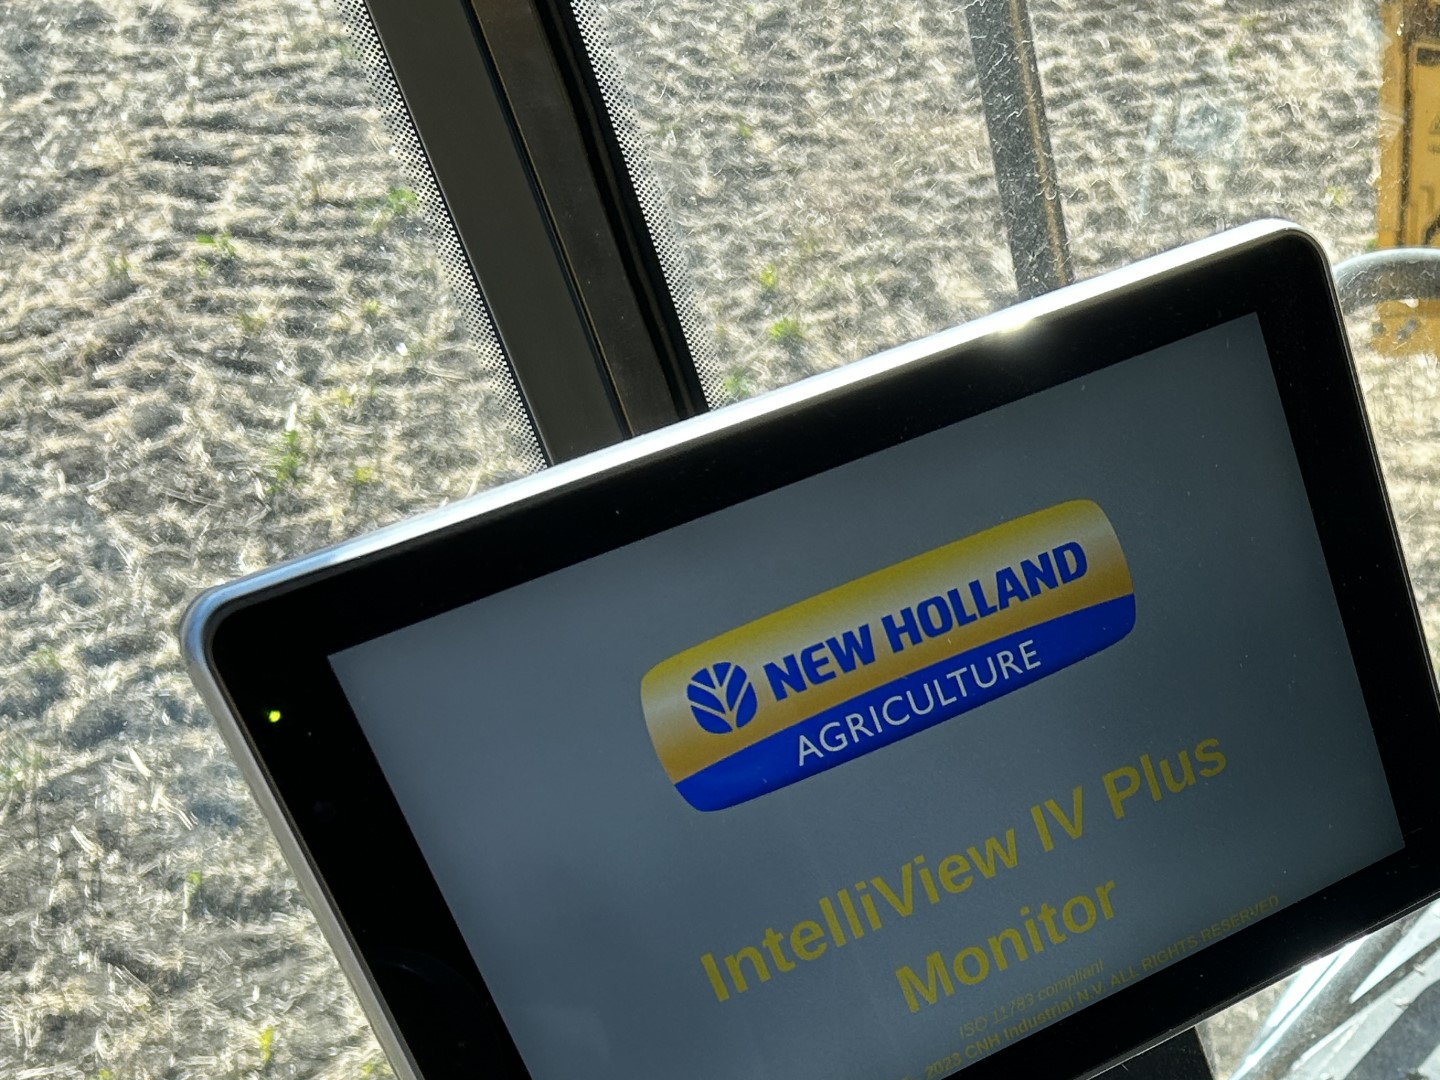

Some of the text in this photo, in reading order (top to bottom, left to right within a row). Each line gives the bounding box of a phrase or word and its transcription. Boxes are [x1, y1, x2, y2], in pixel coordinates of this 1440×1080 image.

[763, 541, 1088, 702] NEW HOLLAND
[799, 639, 1042, 767] AGRICULTURE
[700, 737, 1227, 1002] IntelliView IV Plus
[895, 880, 1116, 1014] Monitor
[960, 1014, 988, 1040] ISO
[1038, 957, 1104, 1000] compliant
[964, 1032, 1002, 1059] CNH
[1003, 993, 1074, 1040] Industrial
[1110, 964, 1140, 988] ALL
[1141, 932, 1199, 970] RIGHTS
[1200, 894, 1280, 942] RESERVED
